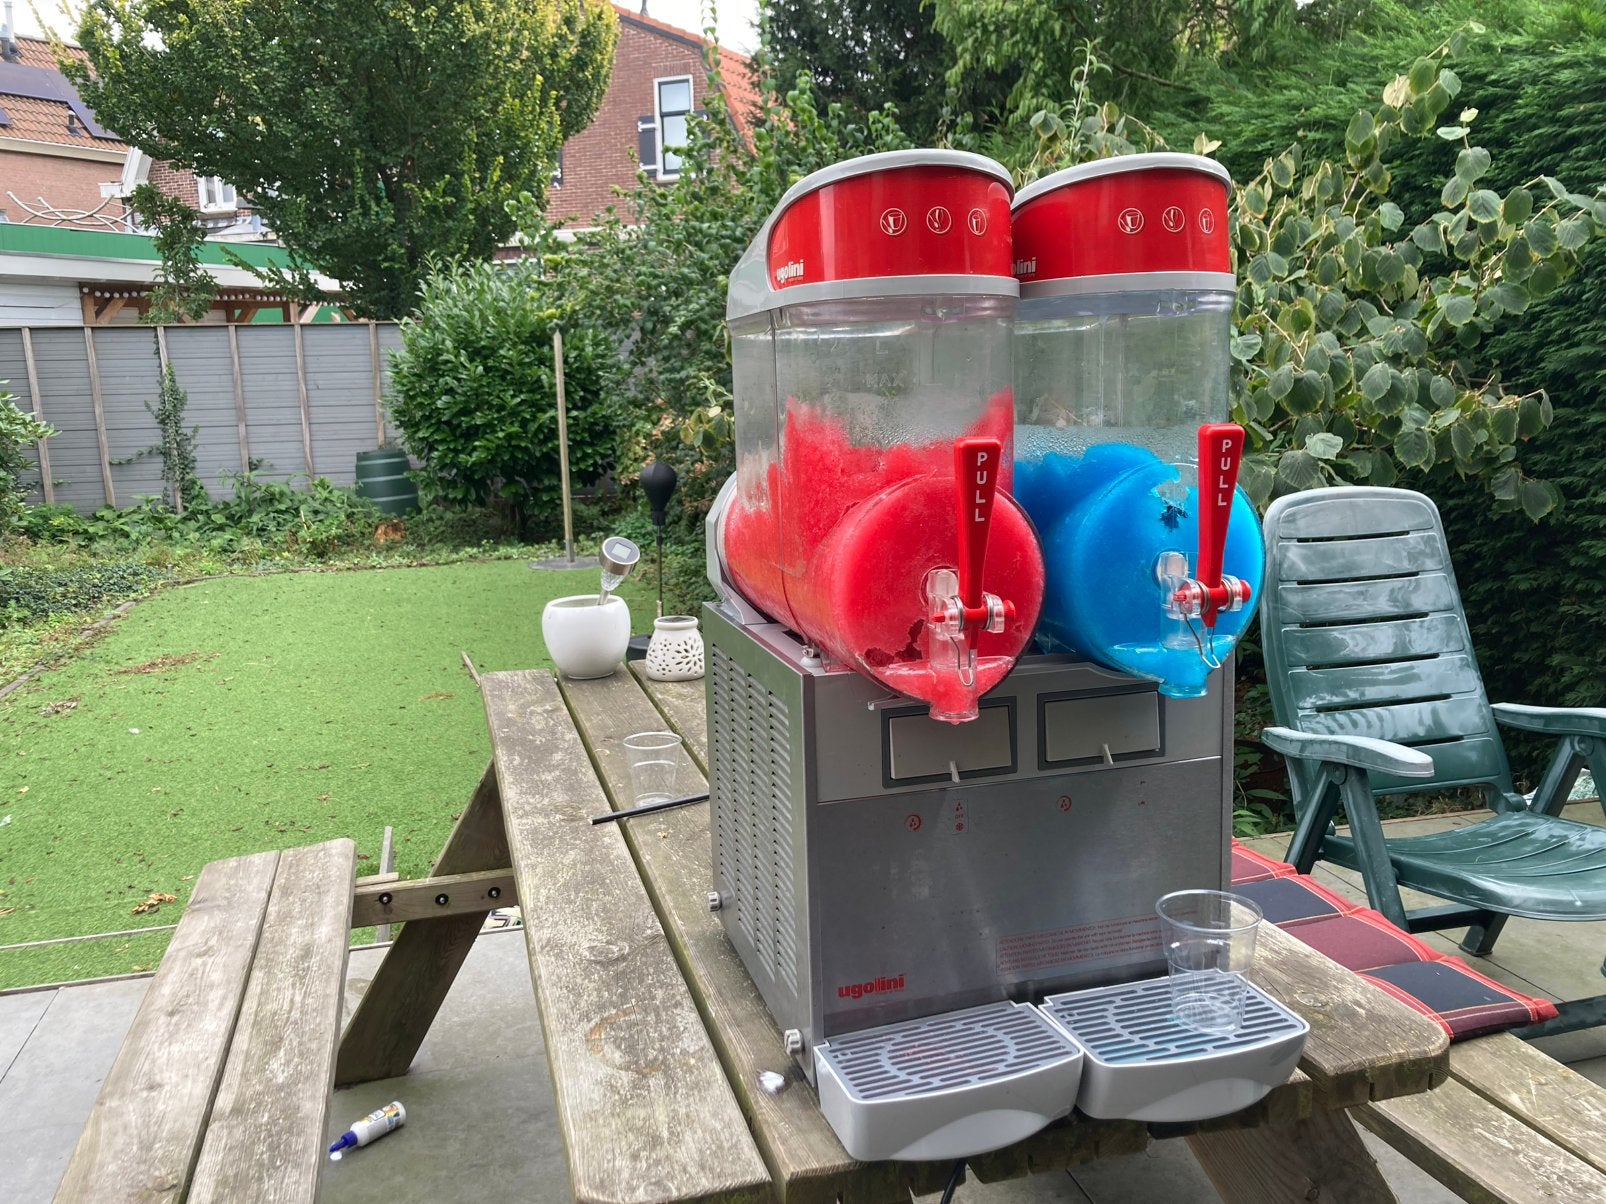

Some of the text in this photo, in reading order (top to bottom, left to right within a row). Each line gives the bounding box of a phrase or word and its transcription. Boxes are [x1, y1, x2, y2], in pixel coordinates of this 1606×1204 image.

[974, 451, 988, 522] PULL
[1217, 439, 1233, 506] PULL
[838, 974, 905, 999] ugolini
